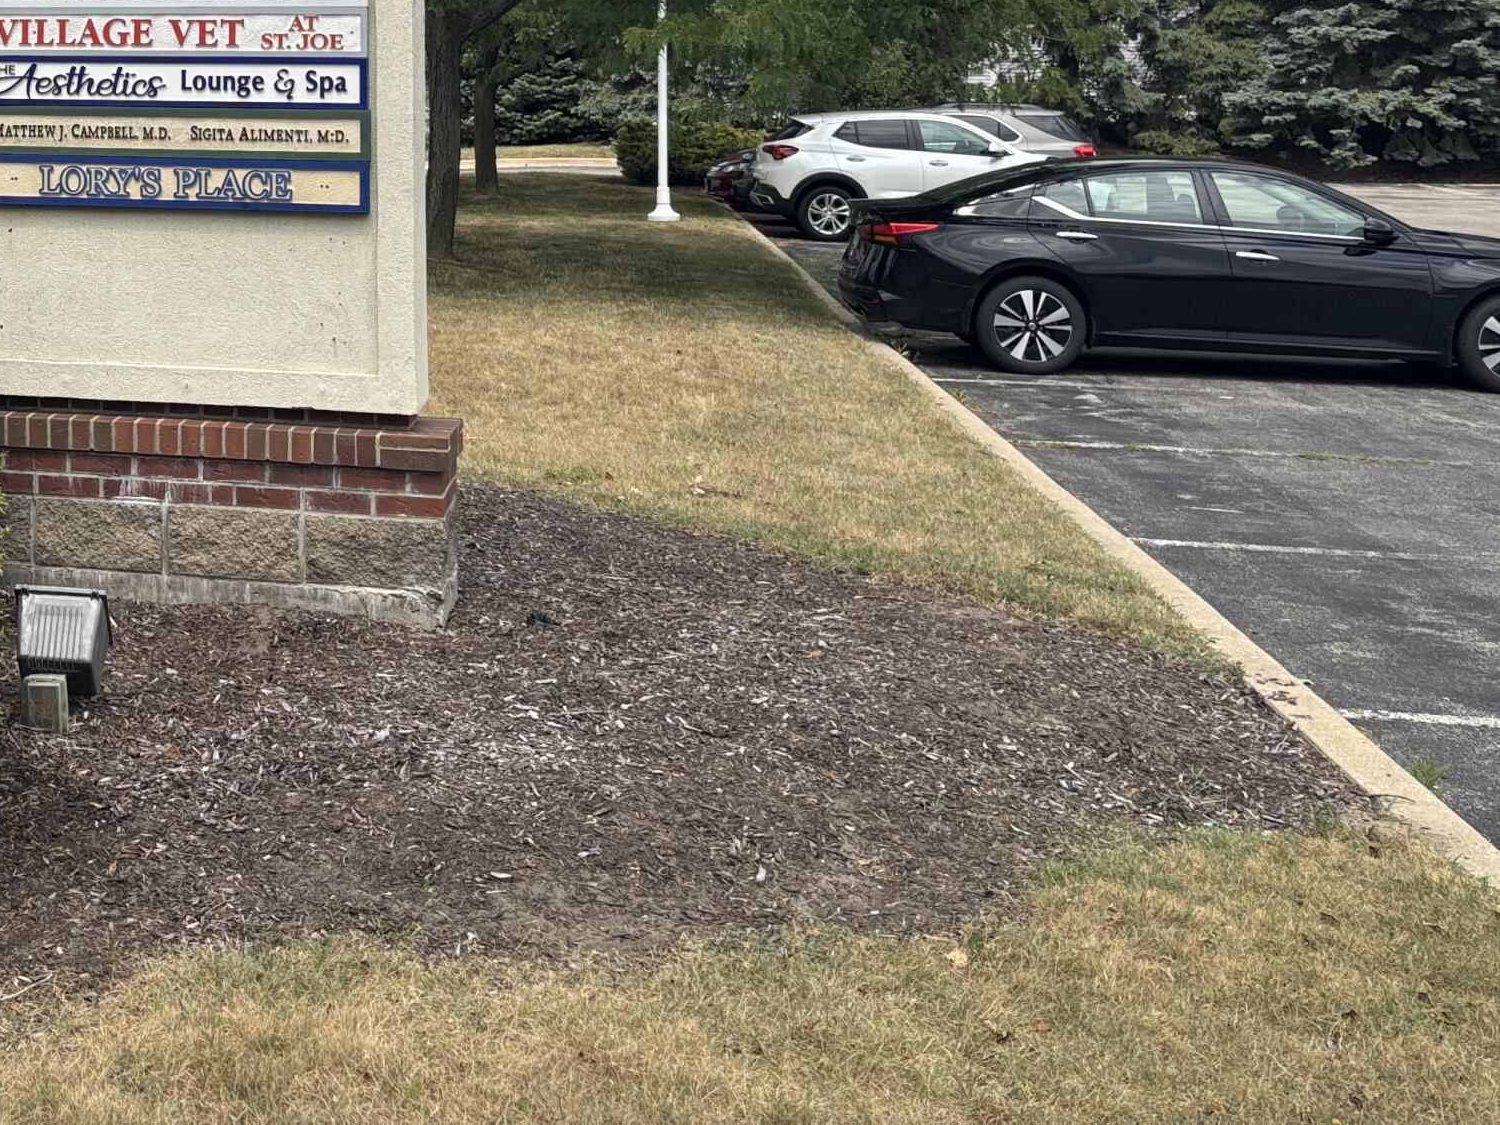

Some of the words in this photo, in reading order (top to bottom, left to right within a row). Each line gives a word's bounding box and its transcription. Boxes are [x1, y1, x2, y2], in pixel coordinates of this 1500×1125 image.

[289, 15, 319, 32] AT
[169, 18, 245, 48] VET
[261, 33, 292, 51] ST.
[296, 33, 344, 51] JOE
[180, 69, 265, 96] Lounge
[273, 69, 295, 100] &
[305, 70, 348, 94] Spa
[59, 125, 67, 142] J.
[142, 126, 172, 141] M.D.
[190, 125, 235, 142] SIGITA
[39, 165, 161, 197] LORY'S
[173, 167, 293, 201] PLACE
